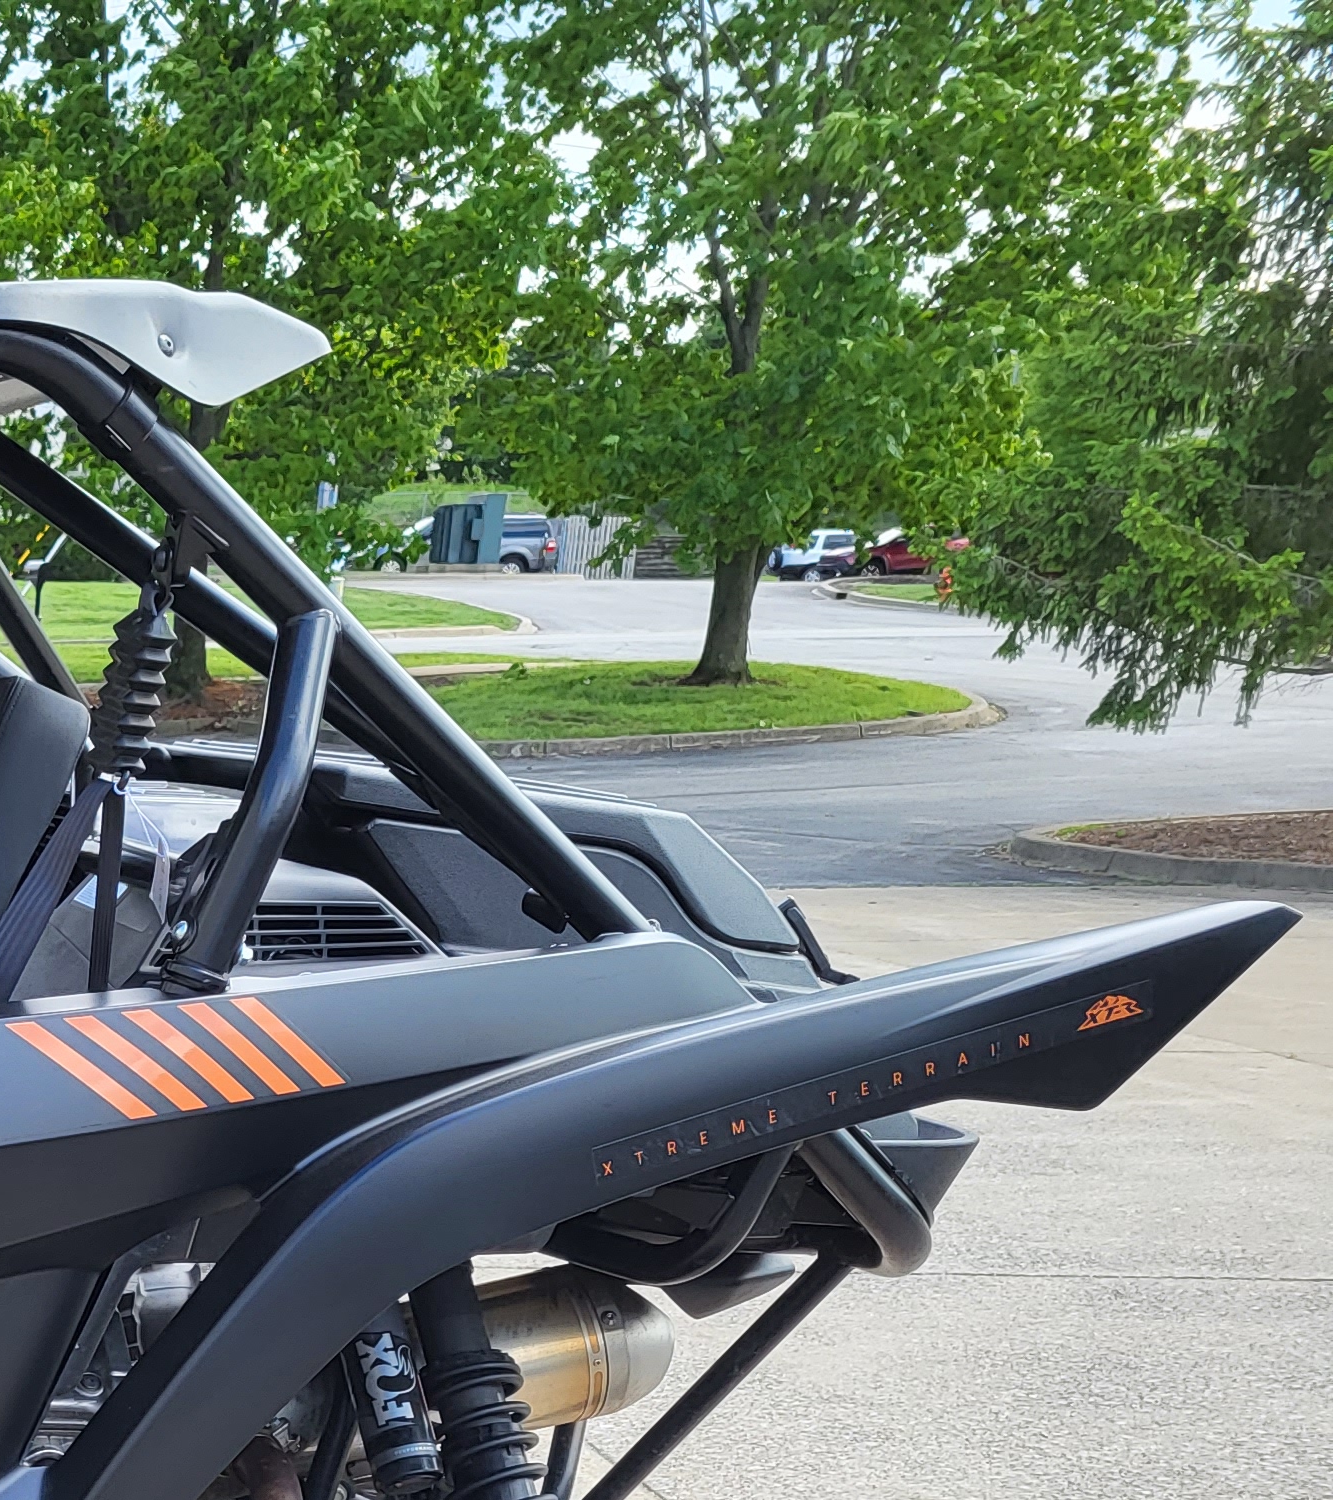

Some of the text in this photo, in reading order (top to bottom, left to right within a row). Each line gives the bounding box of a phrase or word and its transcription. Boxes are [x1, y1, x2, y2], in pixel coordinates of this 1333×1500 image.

[601, 1031, 1032, 1177] XTREME TERRAIN
[354, 1333, 416, 1427] FOX
